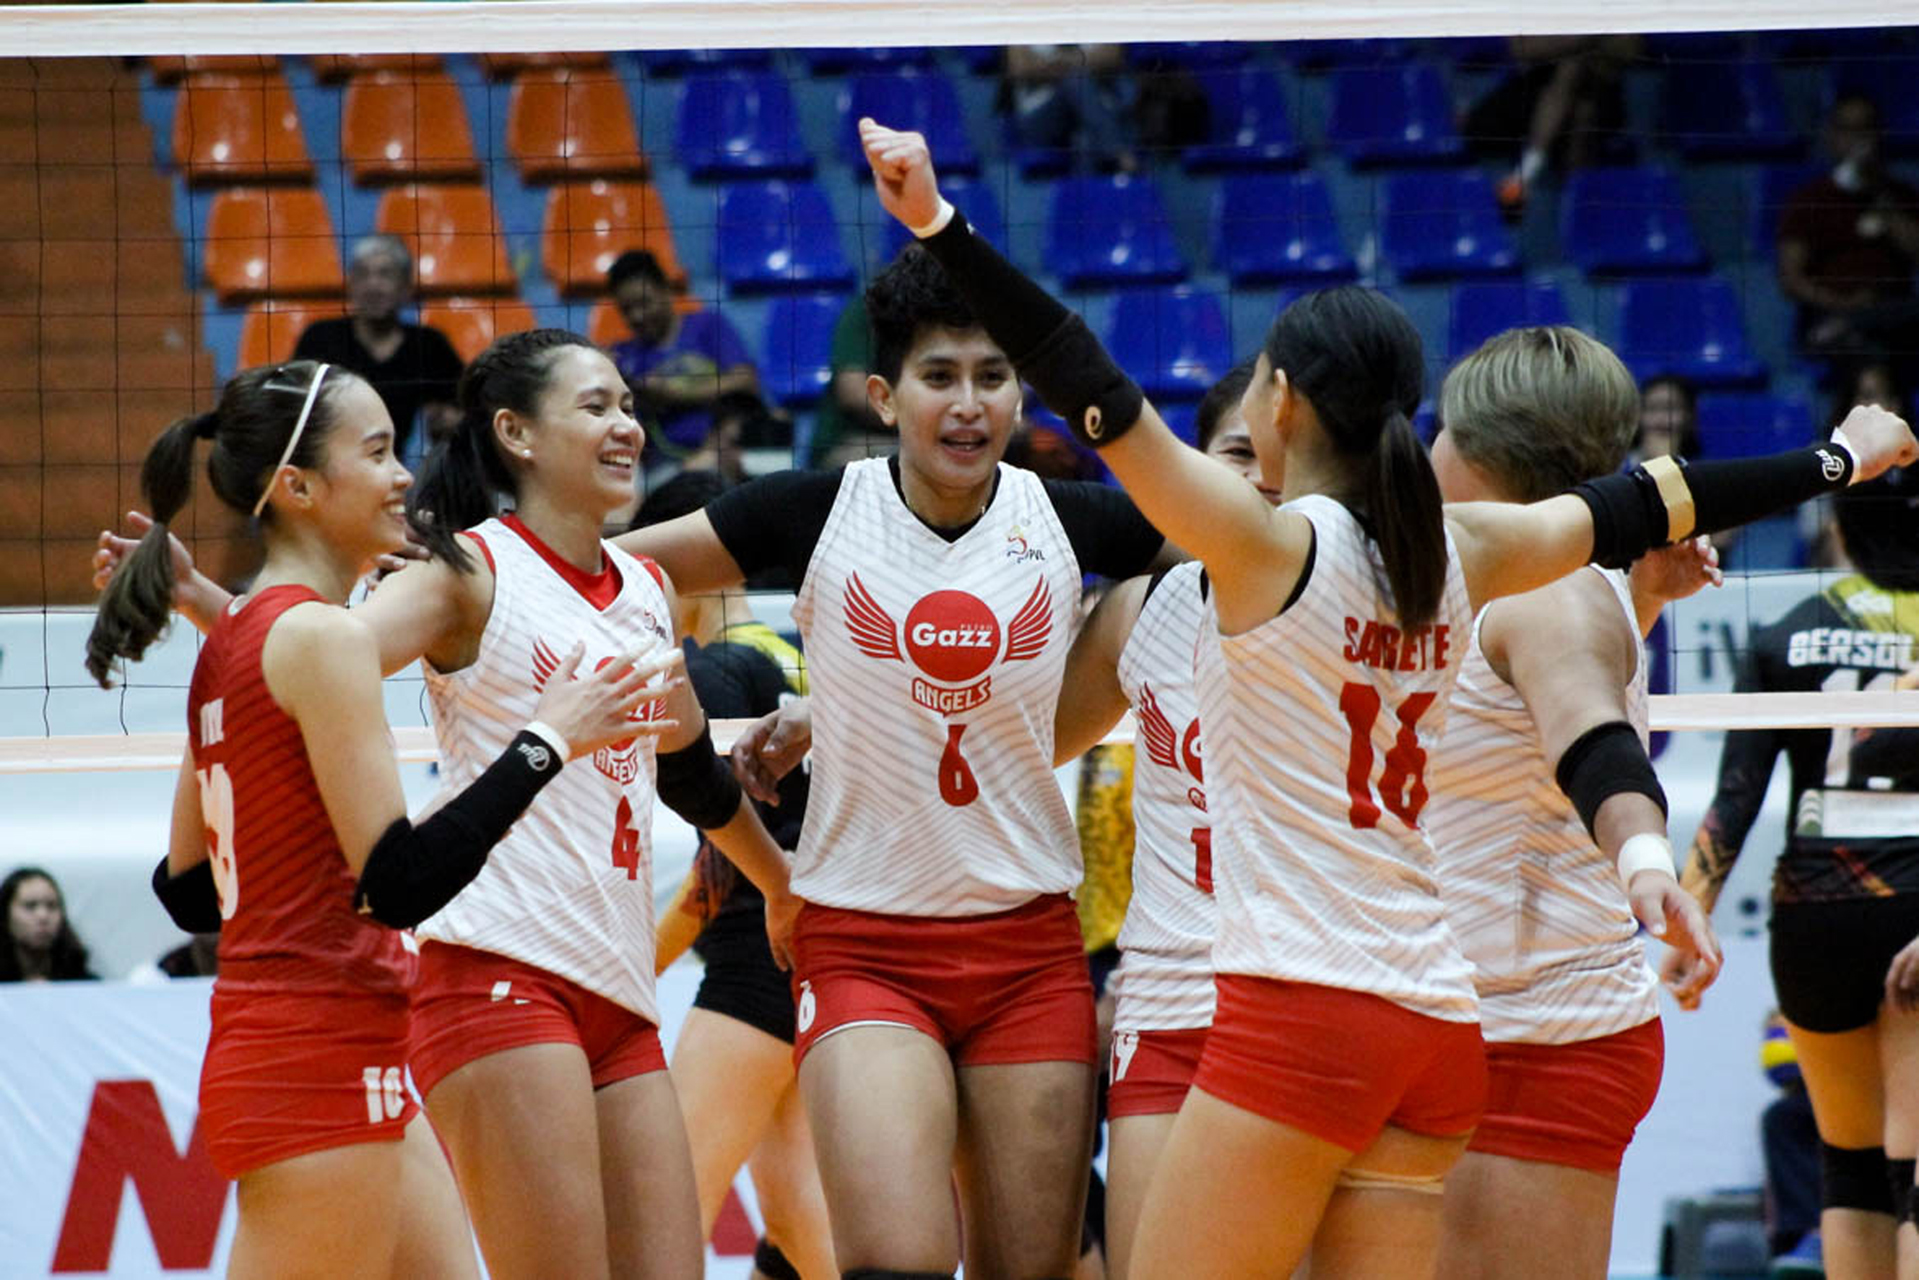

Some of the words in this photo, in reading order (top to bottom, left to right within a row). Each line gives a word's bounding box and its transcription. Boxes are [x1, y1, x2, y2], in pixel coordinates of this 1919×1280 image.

[912, 622, 992, 647] Gazz
[914, 677, 989, 713] ANGELS
[938, 724, 979, 807] 6
[1339, 681, 1438, 830] 16
[611, 795, 640, 880] 4
[798, 979, 816, 1033] 6
